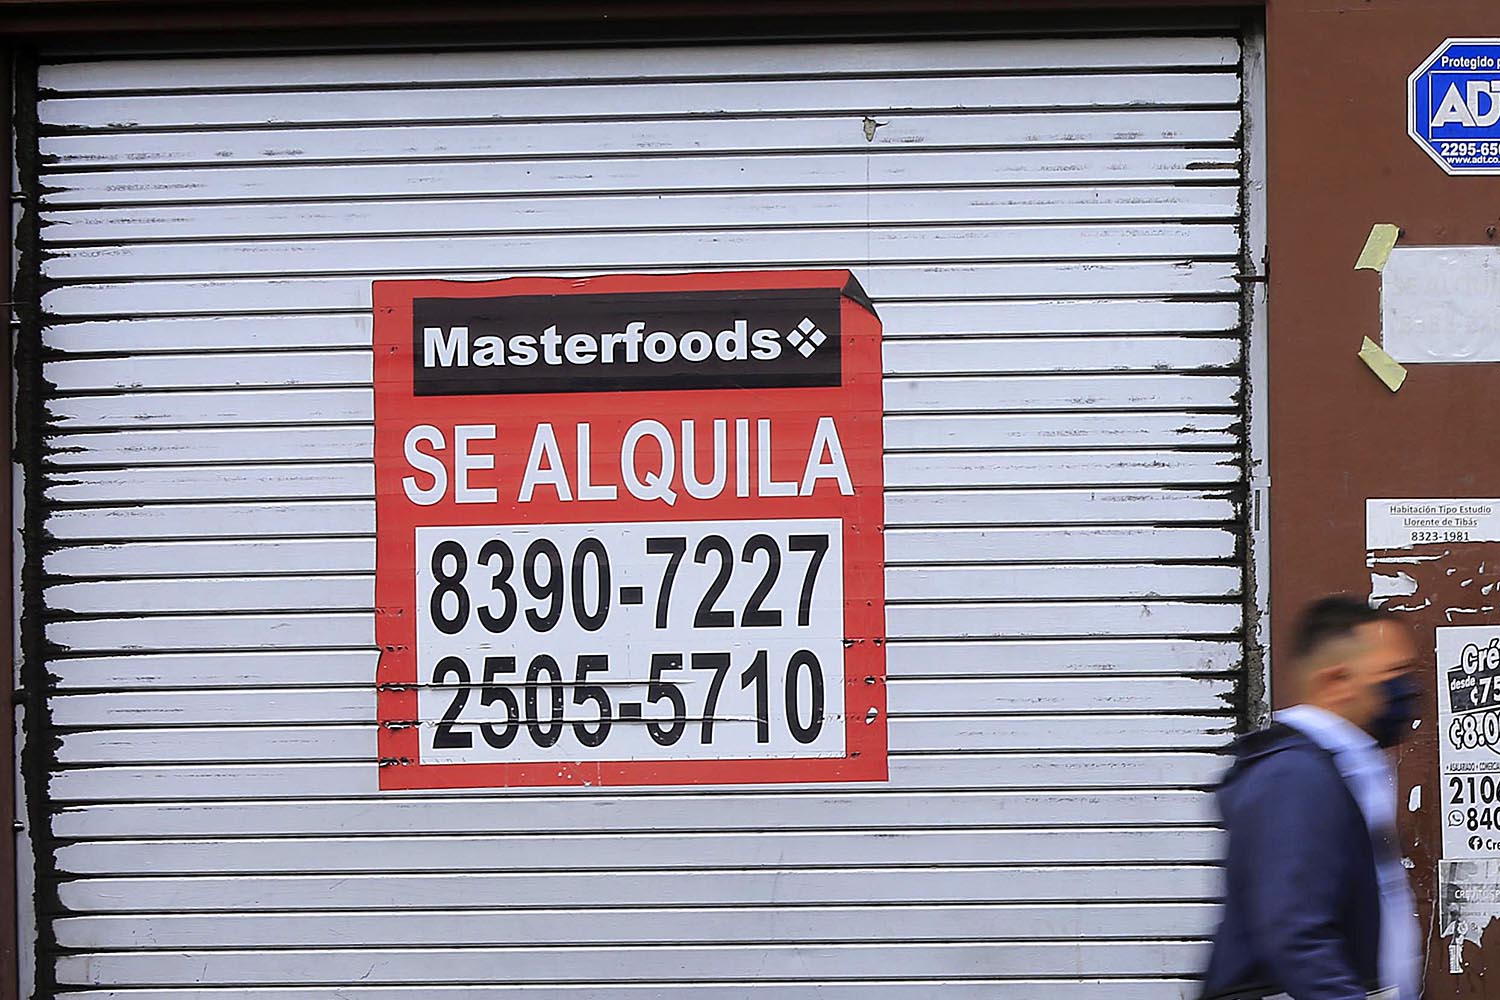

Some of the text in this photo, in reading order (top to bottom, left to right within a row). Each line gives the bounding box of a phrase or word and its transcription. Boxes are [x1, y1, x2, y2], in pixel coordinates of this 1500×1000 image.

[1441, 55, 1494, 70] Protegido
[423, 319, 783, 368] Masterfoods
[402, 416, 855, 506] SE ALQUILA
[1390, 505, 1492, 514] Habitación Tipo Estudio
[1404, 518, 1478, 526] Llorente de Tibás
[1411, 531, 1470, 542] 8323-1981
[430, 533, 830, 635] 8390-7227
[1450, 675, 1476, 691] desde
[431, 649, 825, 750] 2505-5710
